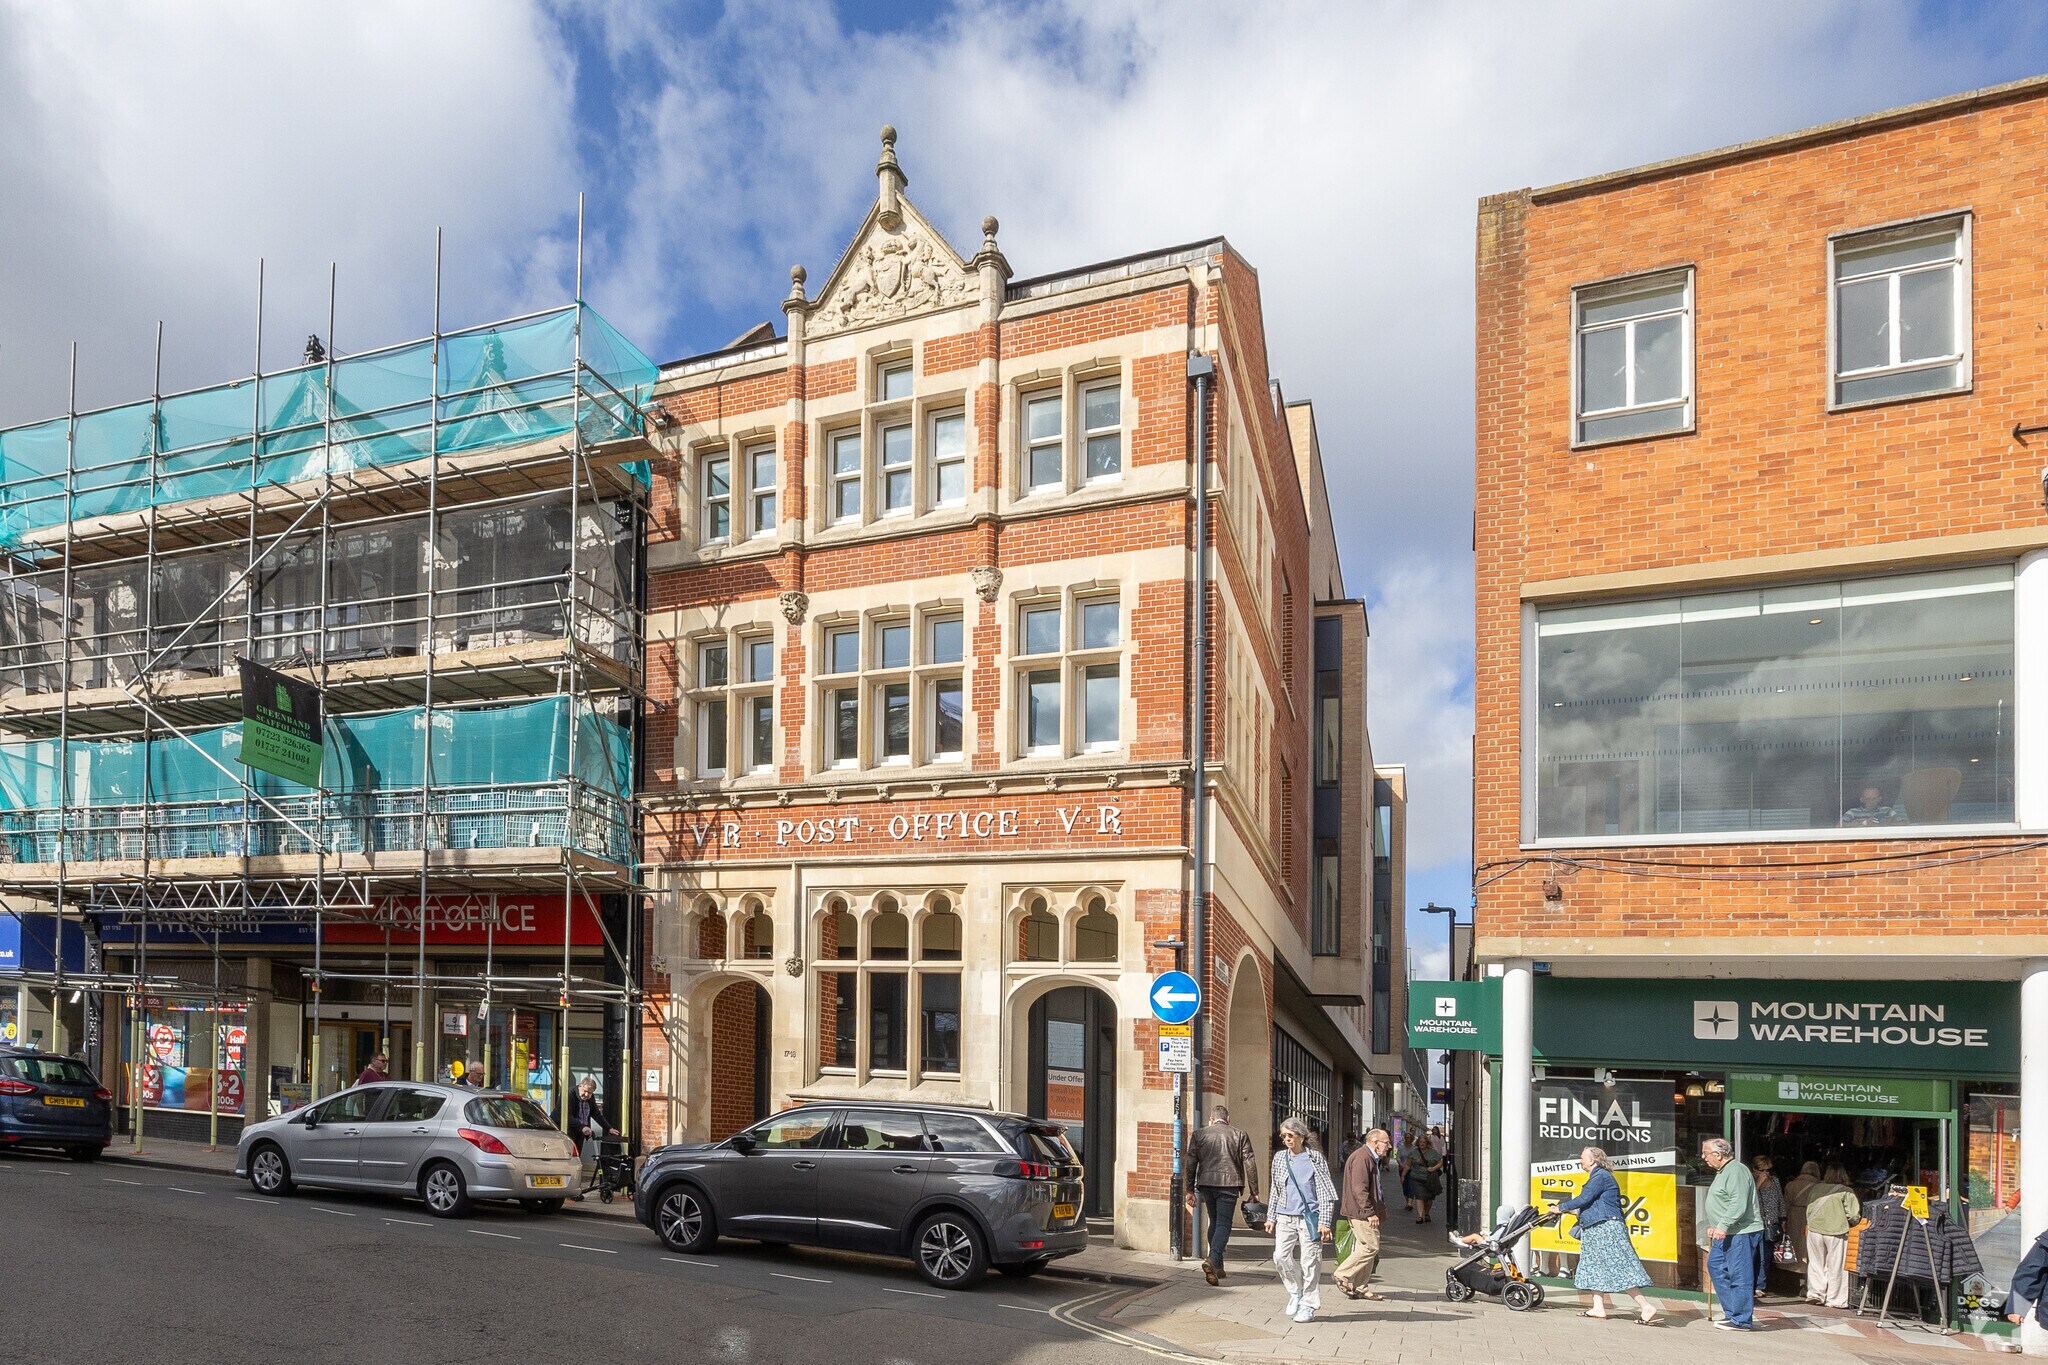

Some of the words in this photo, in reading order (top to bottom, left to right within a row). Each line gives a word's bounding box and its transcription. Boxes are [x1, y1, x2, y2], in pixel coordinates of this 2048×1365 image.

[256, 705, 311, 730] GREENBAND
[256, 714, 311, 739] SCAFFOLDING
[255, 740, 280, 754] 01737
[256, 727, 280, 742] 07723
[282, 736, 311, 753] 326365
[776, 816, 860, 846] POST
[887, 809, 1019, 841] OFFICE
[379, 906, 440, 931] POST
[445, 905, 536, 932] OFFICE
[1750, 1001, 1946, 1022] MOUNTAIN
[1414, 1026, 1478, 1034] WAREHOUSE
[1419, 1019, 1472, 1027] MOUNTAIN
[155, 1033, 172, 1048] £2
[230, 1036, 245, 1044] Half
[1749, 1024, 1989, 1047] WAREHOUSE
[228, 1074, 240, 1095] 2
[1048, 1074, 1066, 1082] Under
[1800, 1082, 1882, 1093] MOUNTAIN
[1800, 1092, 1899, 1104] WAREHOUSE
[1050, 1109, 1082, 1118] Merrifields
[1539, 1097, 1651, 1128] FINAL
[1539, 1124, 1651, 1143] REDUCTIONS
[1536, 1163, 1573, 1173] LIMITED
[1612, 1156, 1656, 1166] MAINING
[1559, 1179, 1574, 1188] TO
[1630, 1225, 1650, 1236] FF
